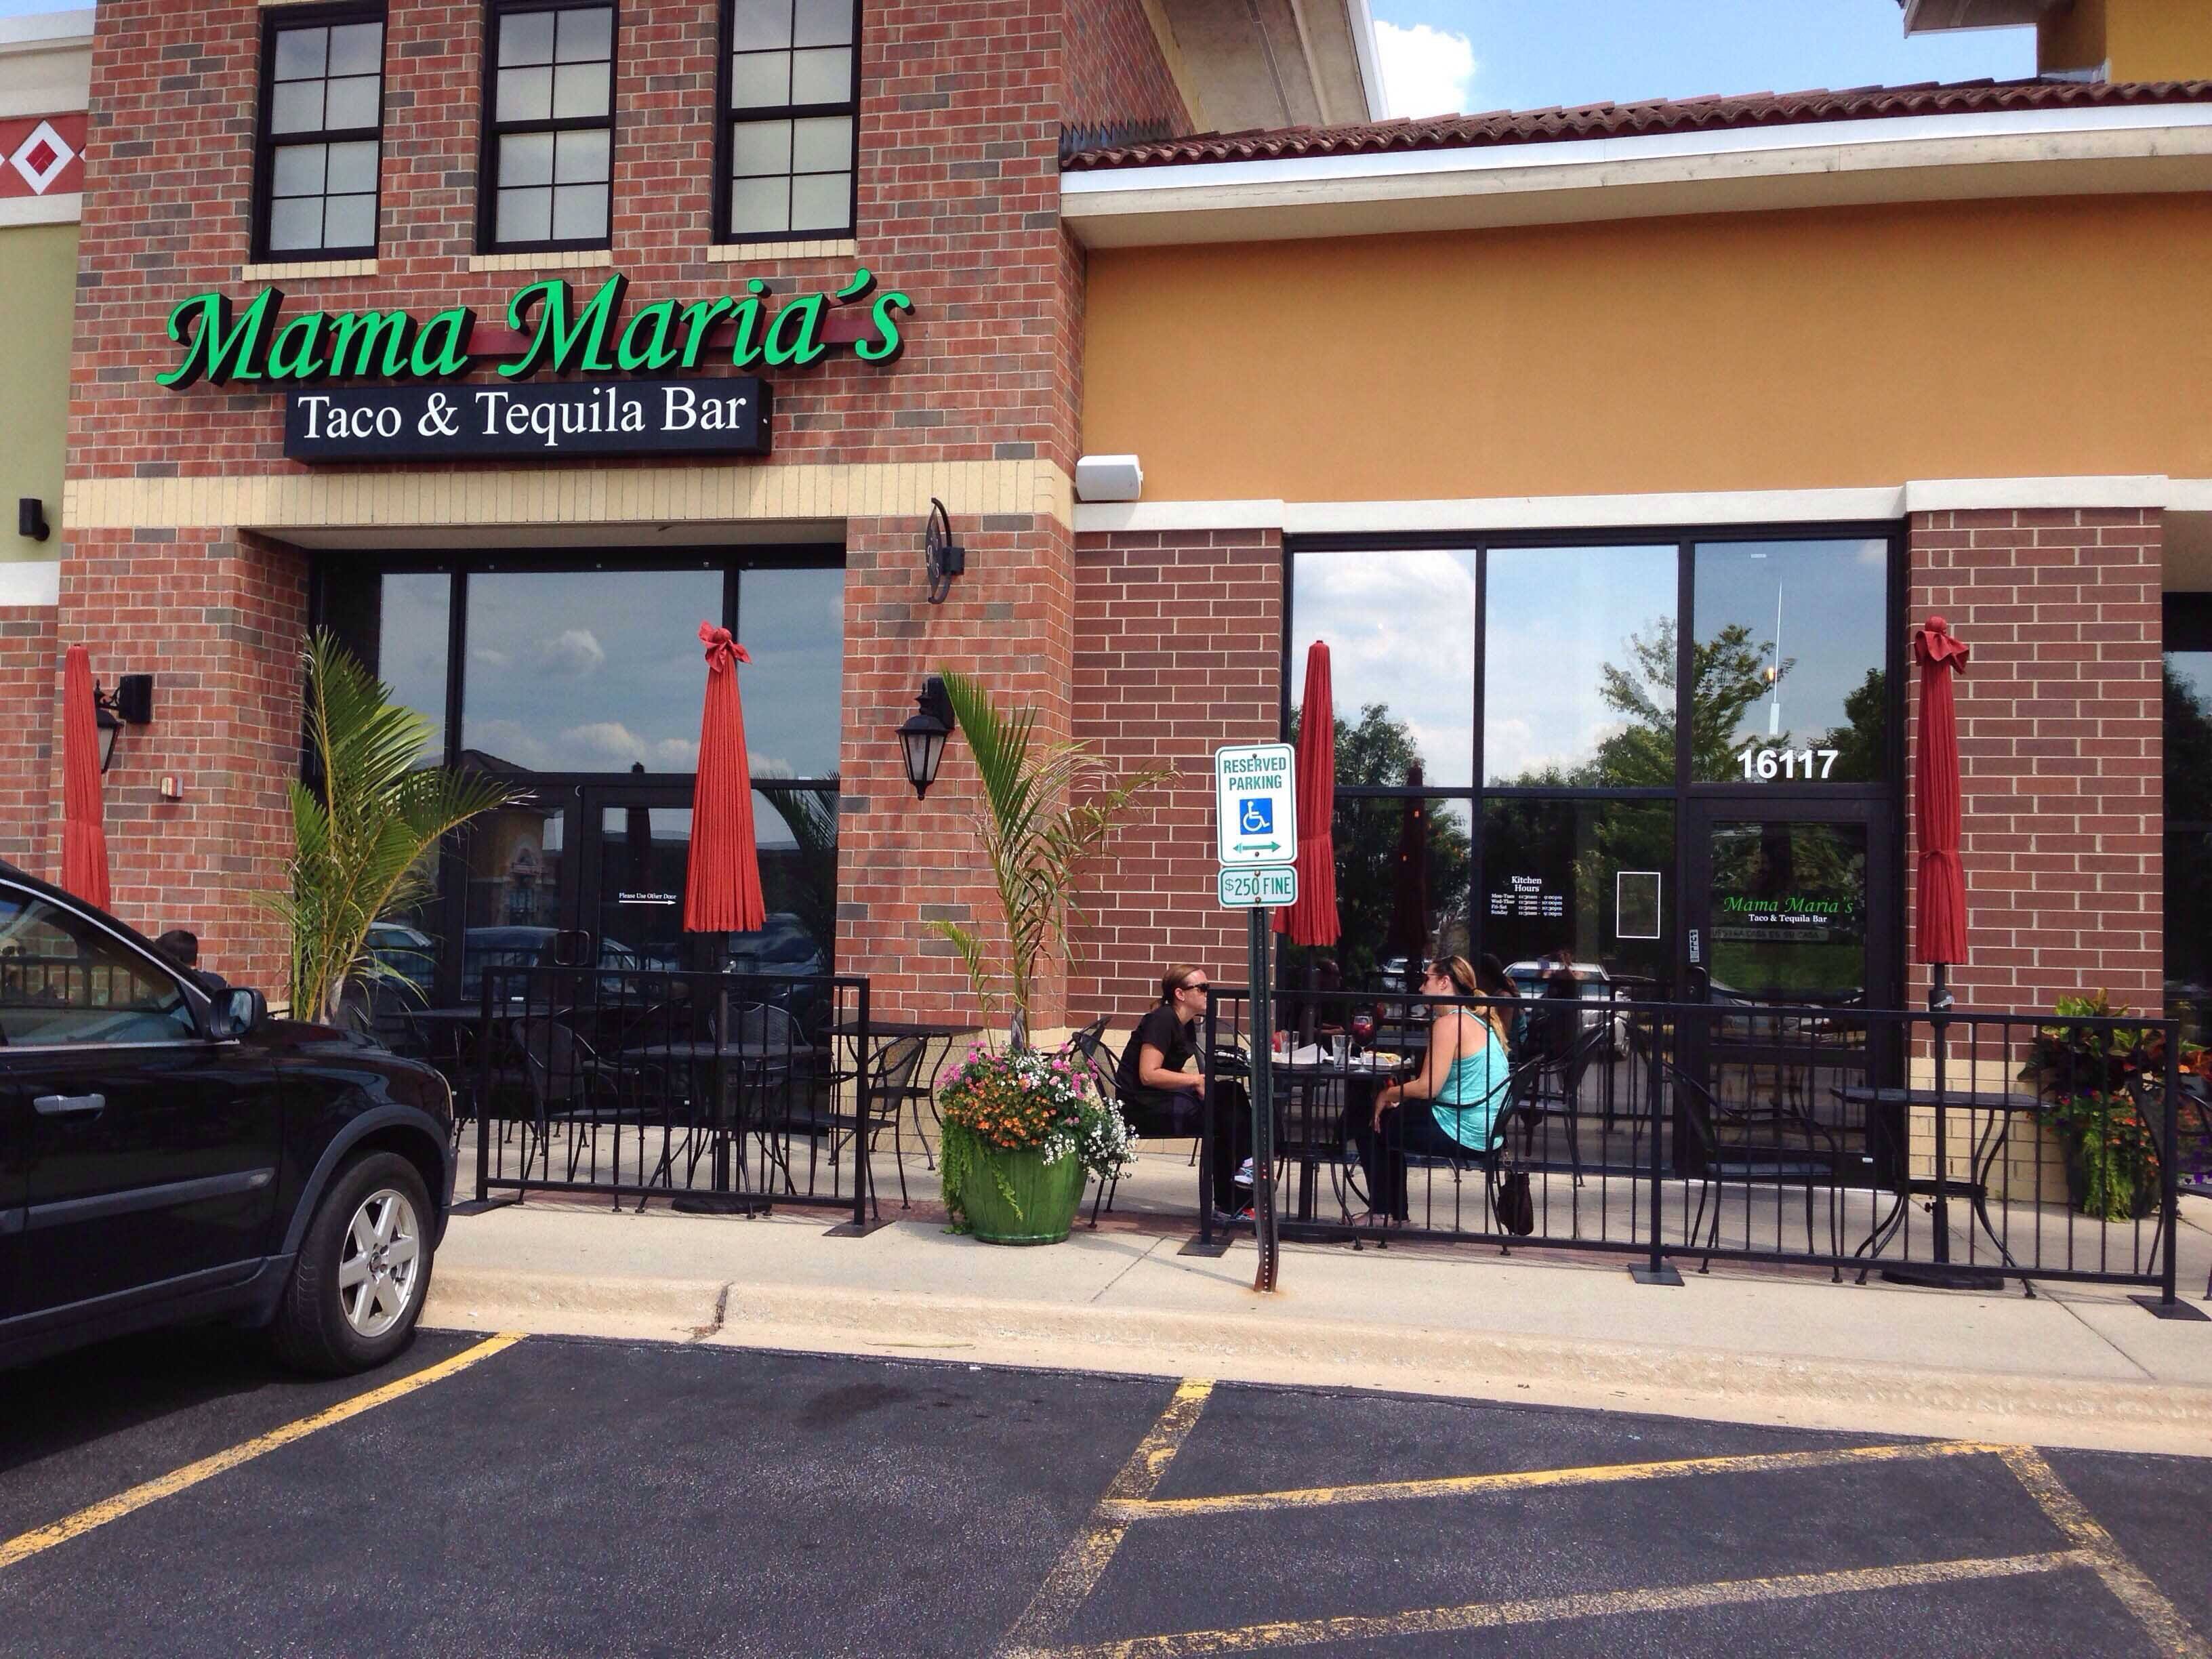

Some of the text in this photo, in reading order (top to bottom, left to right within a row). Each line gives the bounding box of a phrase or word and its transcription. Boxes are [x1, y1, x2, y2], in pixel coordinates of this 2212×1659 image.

[156, 268, 912, 386] Mama Maria's
[298, 386, 747, 447] Taco & Tequila Bar
[1223, 757, 1286, 774] RESERVED
[1738, 750, 1839, 779] 16117
[1229, 775, 1282, 791] PARKING
[1225, 876, 1291, 896] $250 FINE
[1511, 876, 1542, 884] Kitchen
[1515, 884, 1540, 892] Hours
[1723, 897, 1853, 914] Mama Maria's
[1748, 914, 1828, 924] Taco & Tequila Bar
